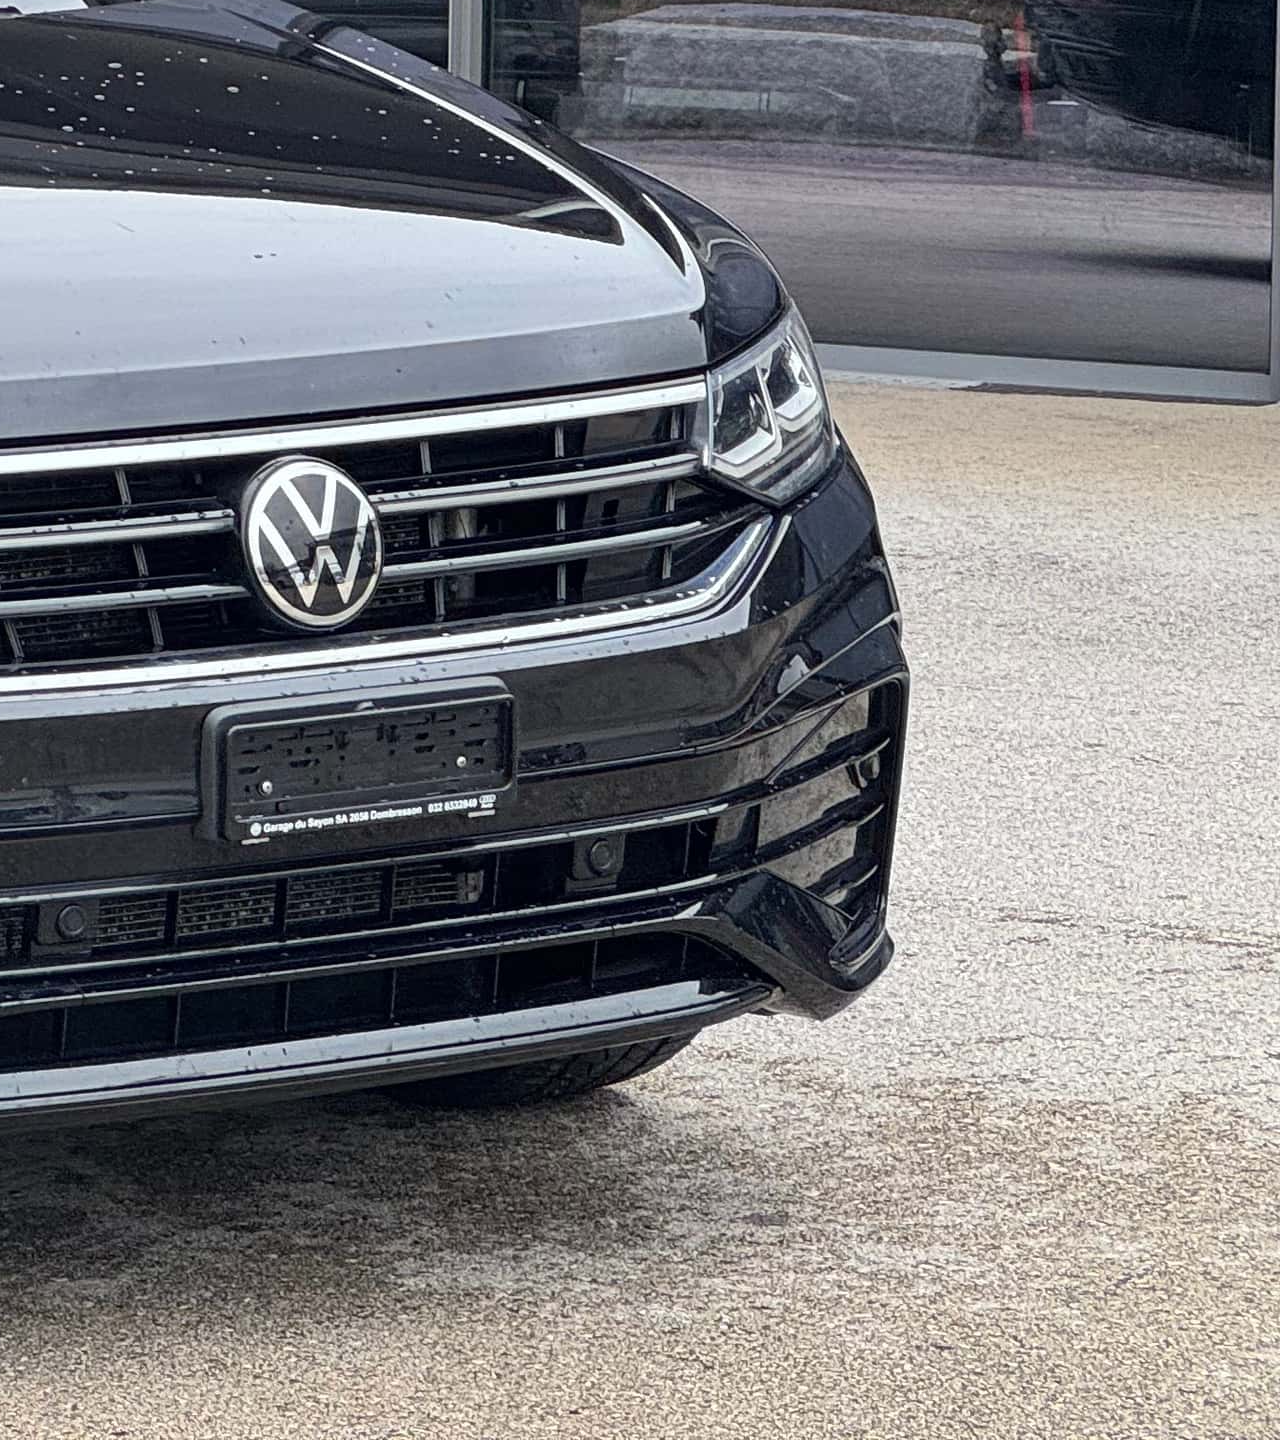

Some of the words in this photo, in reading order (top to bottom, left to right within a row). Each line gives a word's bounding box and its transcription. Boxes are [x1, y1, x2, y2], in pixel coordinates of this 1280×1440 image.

[263, 821, 294, 833] Garage
[295, 819, 307, 830] du
[307, 817, 334, 829] Seyon
[335, 813, 348, 825] SA
